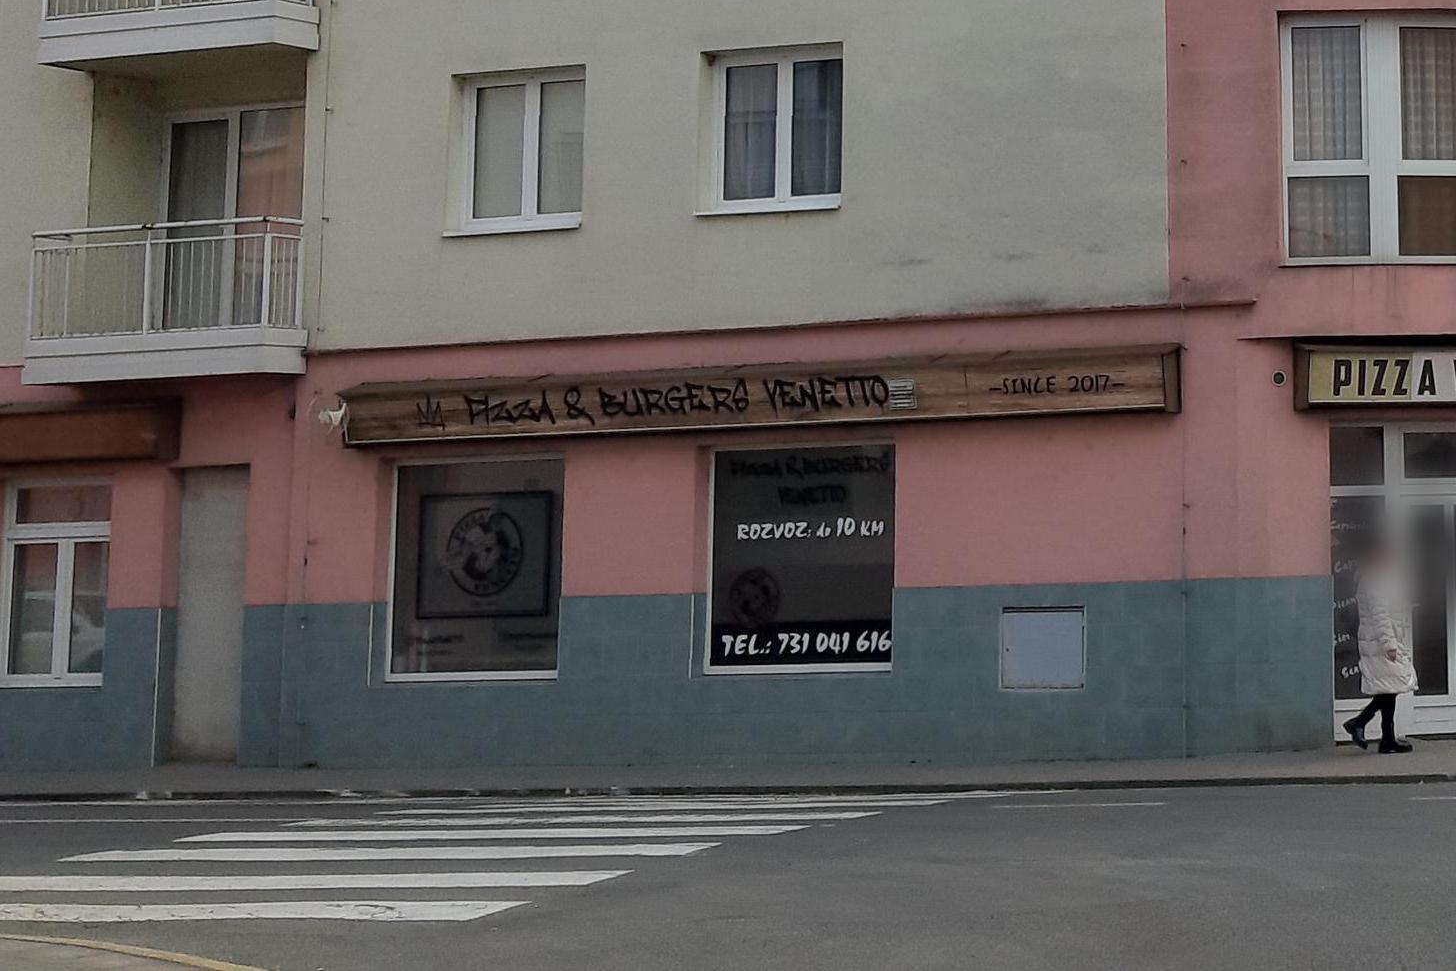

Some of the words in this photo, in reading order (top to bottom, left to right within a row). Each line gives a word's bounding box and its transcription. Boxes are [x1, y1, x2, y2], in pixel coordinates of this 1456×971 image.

[1333, 359, 1437, 396] PIZZA
[564, 386, 595, 425] &
[599, 377, 750, 417] BURGERS
[763, 375, 889, 415] VENETTO
[736, 521, 812, 540] ROZVOZ:
[836, 516, 856, 537] 10
[860, 520, 885, 537] KM
[777, 632, 810, 655] 731
[815, 631, 851, 654] 041
[856, 629, 892, 652] 616
